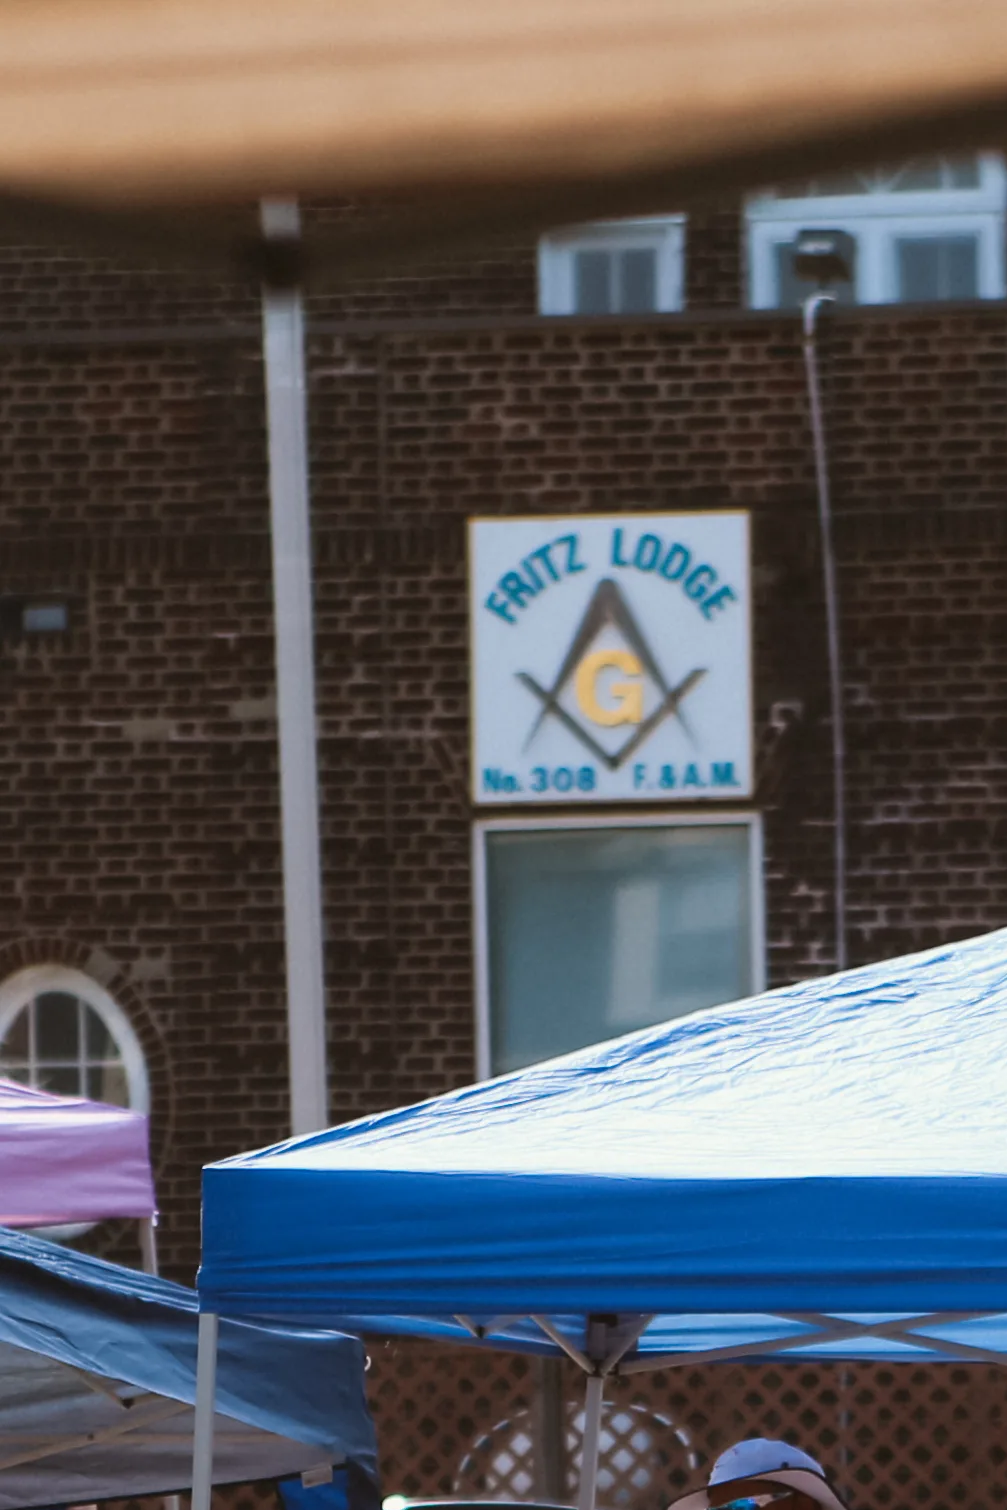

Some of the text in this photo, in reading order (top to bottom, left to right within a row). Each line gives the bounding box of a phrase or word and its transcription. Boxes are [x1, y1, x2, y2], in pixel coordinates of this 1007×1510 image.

[484, 528, 738, 625] FRITZ LODGE
[575, 649, 644, 727] G
[530, 766, 596, 792] 308
